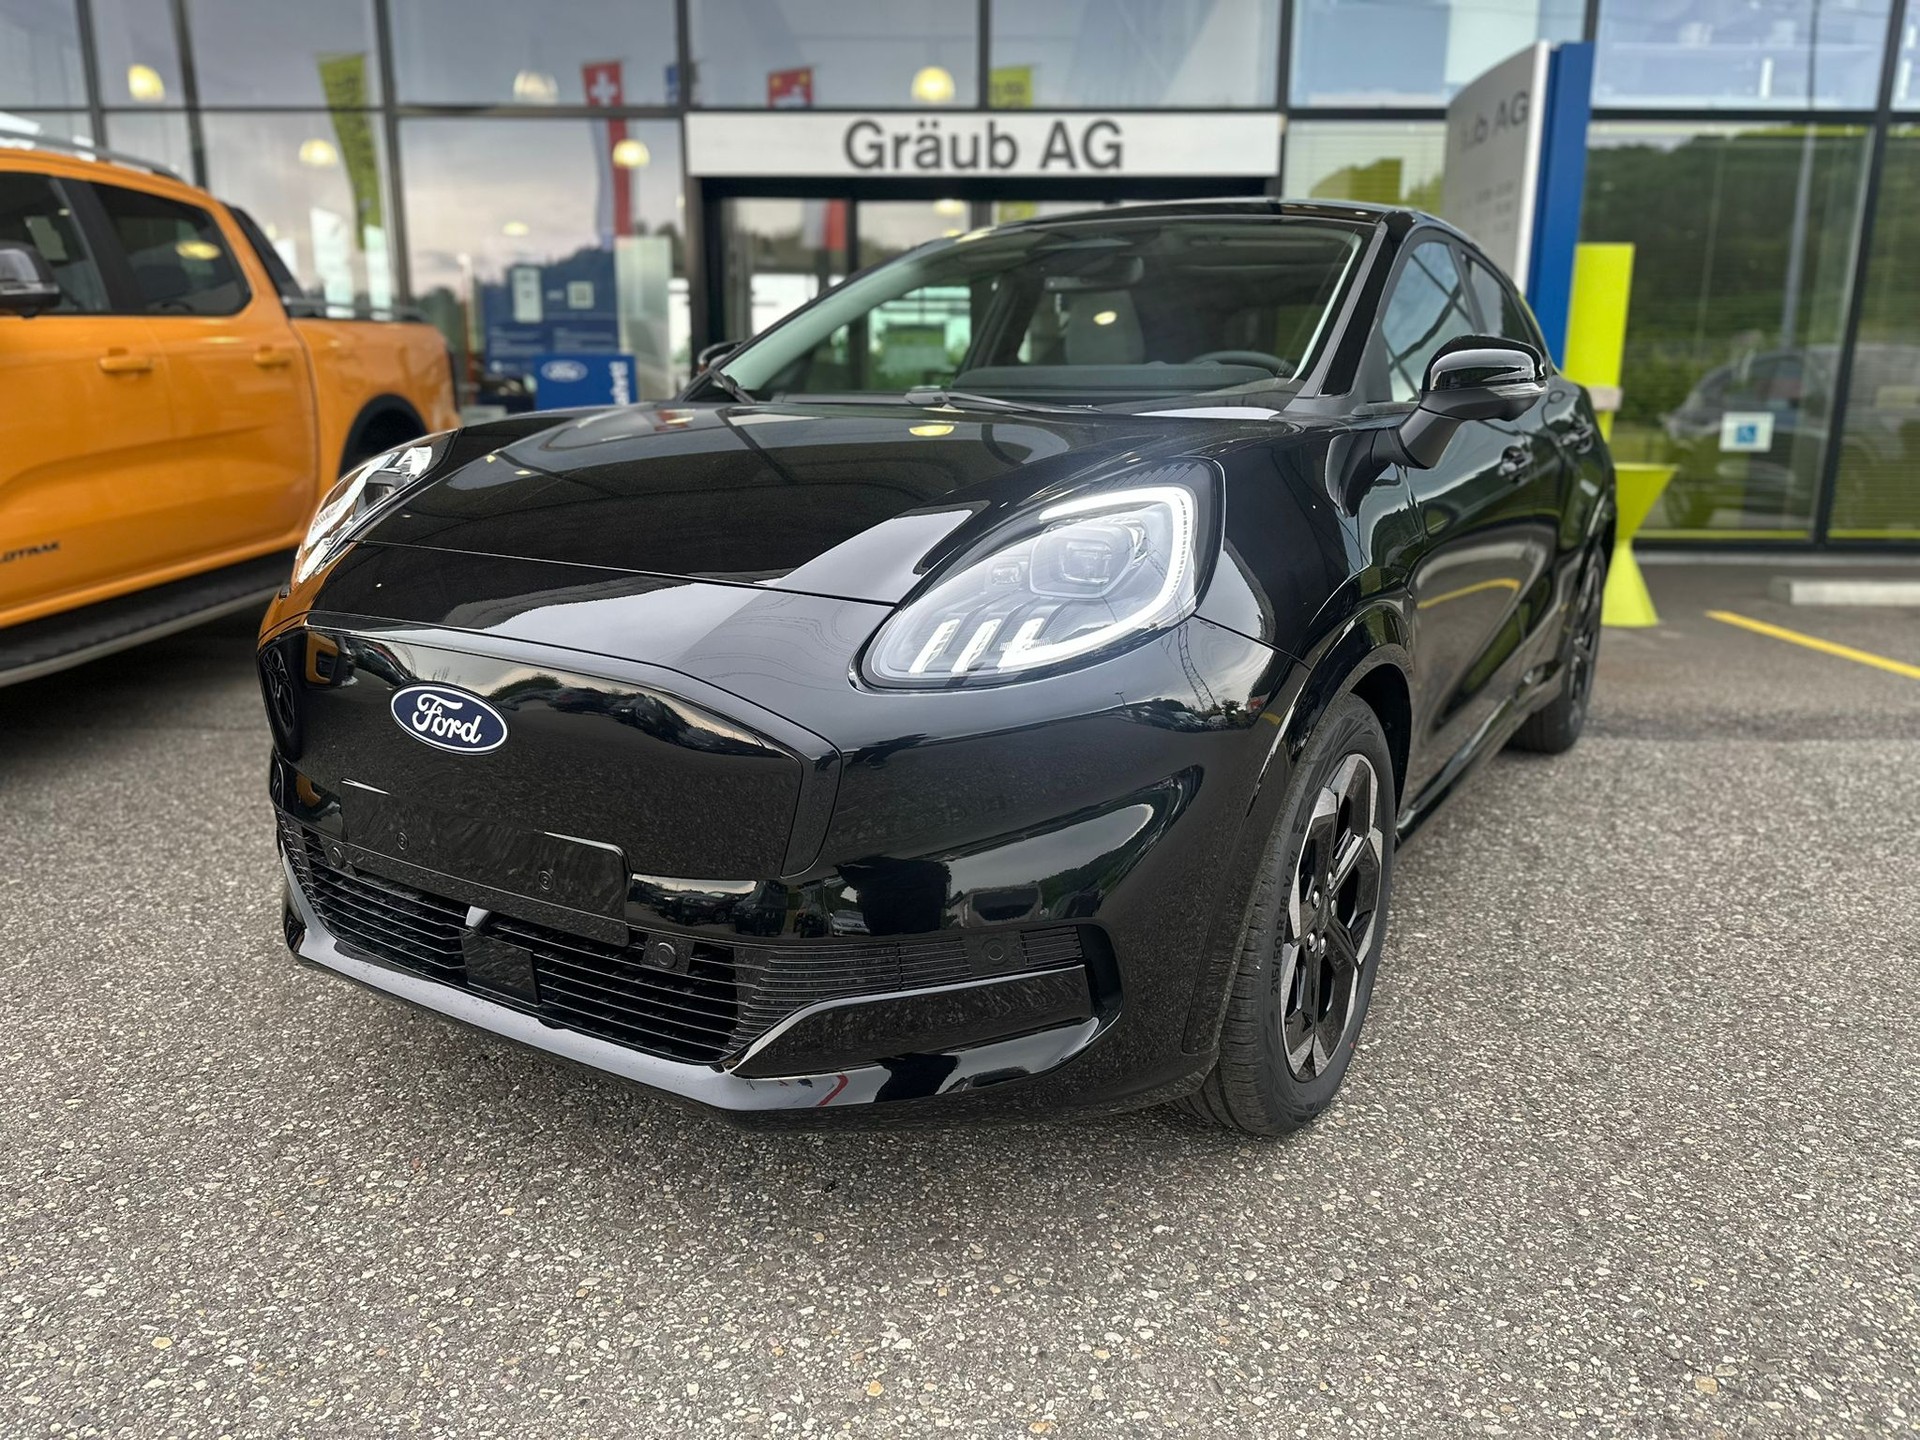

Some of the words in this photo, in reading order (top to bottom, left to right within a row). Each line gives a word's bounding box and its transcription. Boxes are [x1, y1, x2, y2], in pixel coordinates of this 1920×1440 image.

[1492, 89, 1530, 136] AG
[844, 119, 1019, 170] Gräub
[1039, 119, 1123, 170] AG
[412, 693, 483, 744] Ford
[1276, 919, 1285, 931] R
[1279, 896, 1289, 914] 18
[1270, 936, 1283, 996] 215/50
